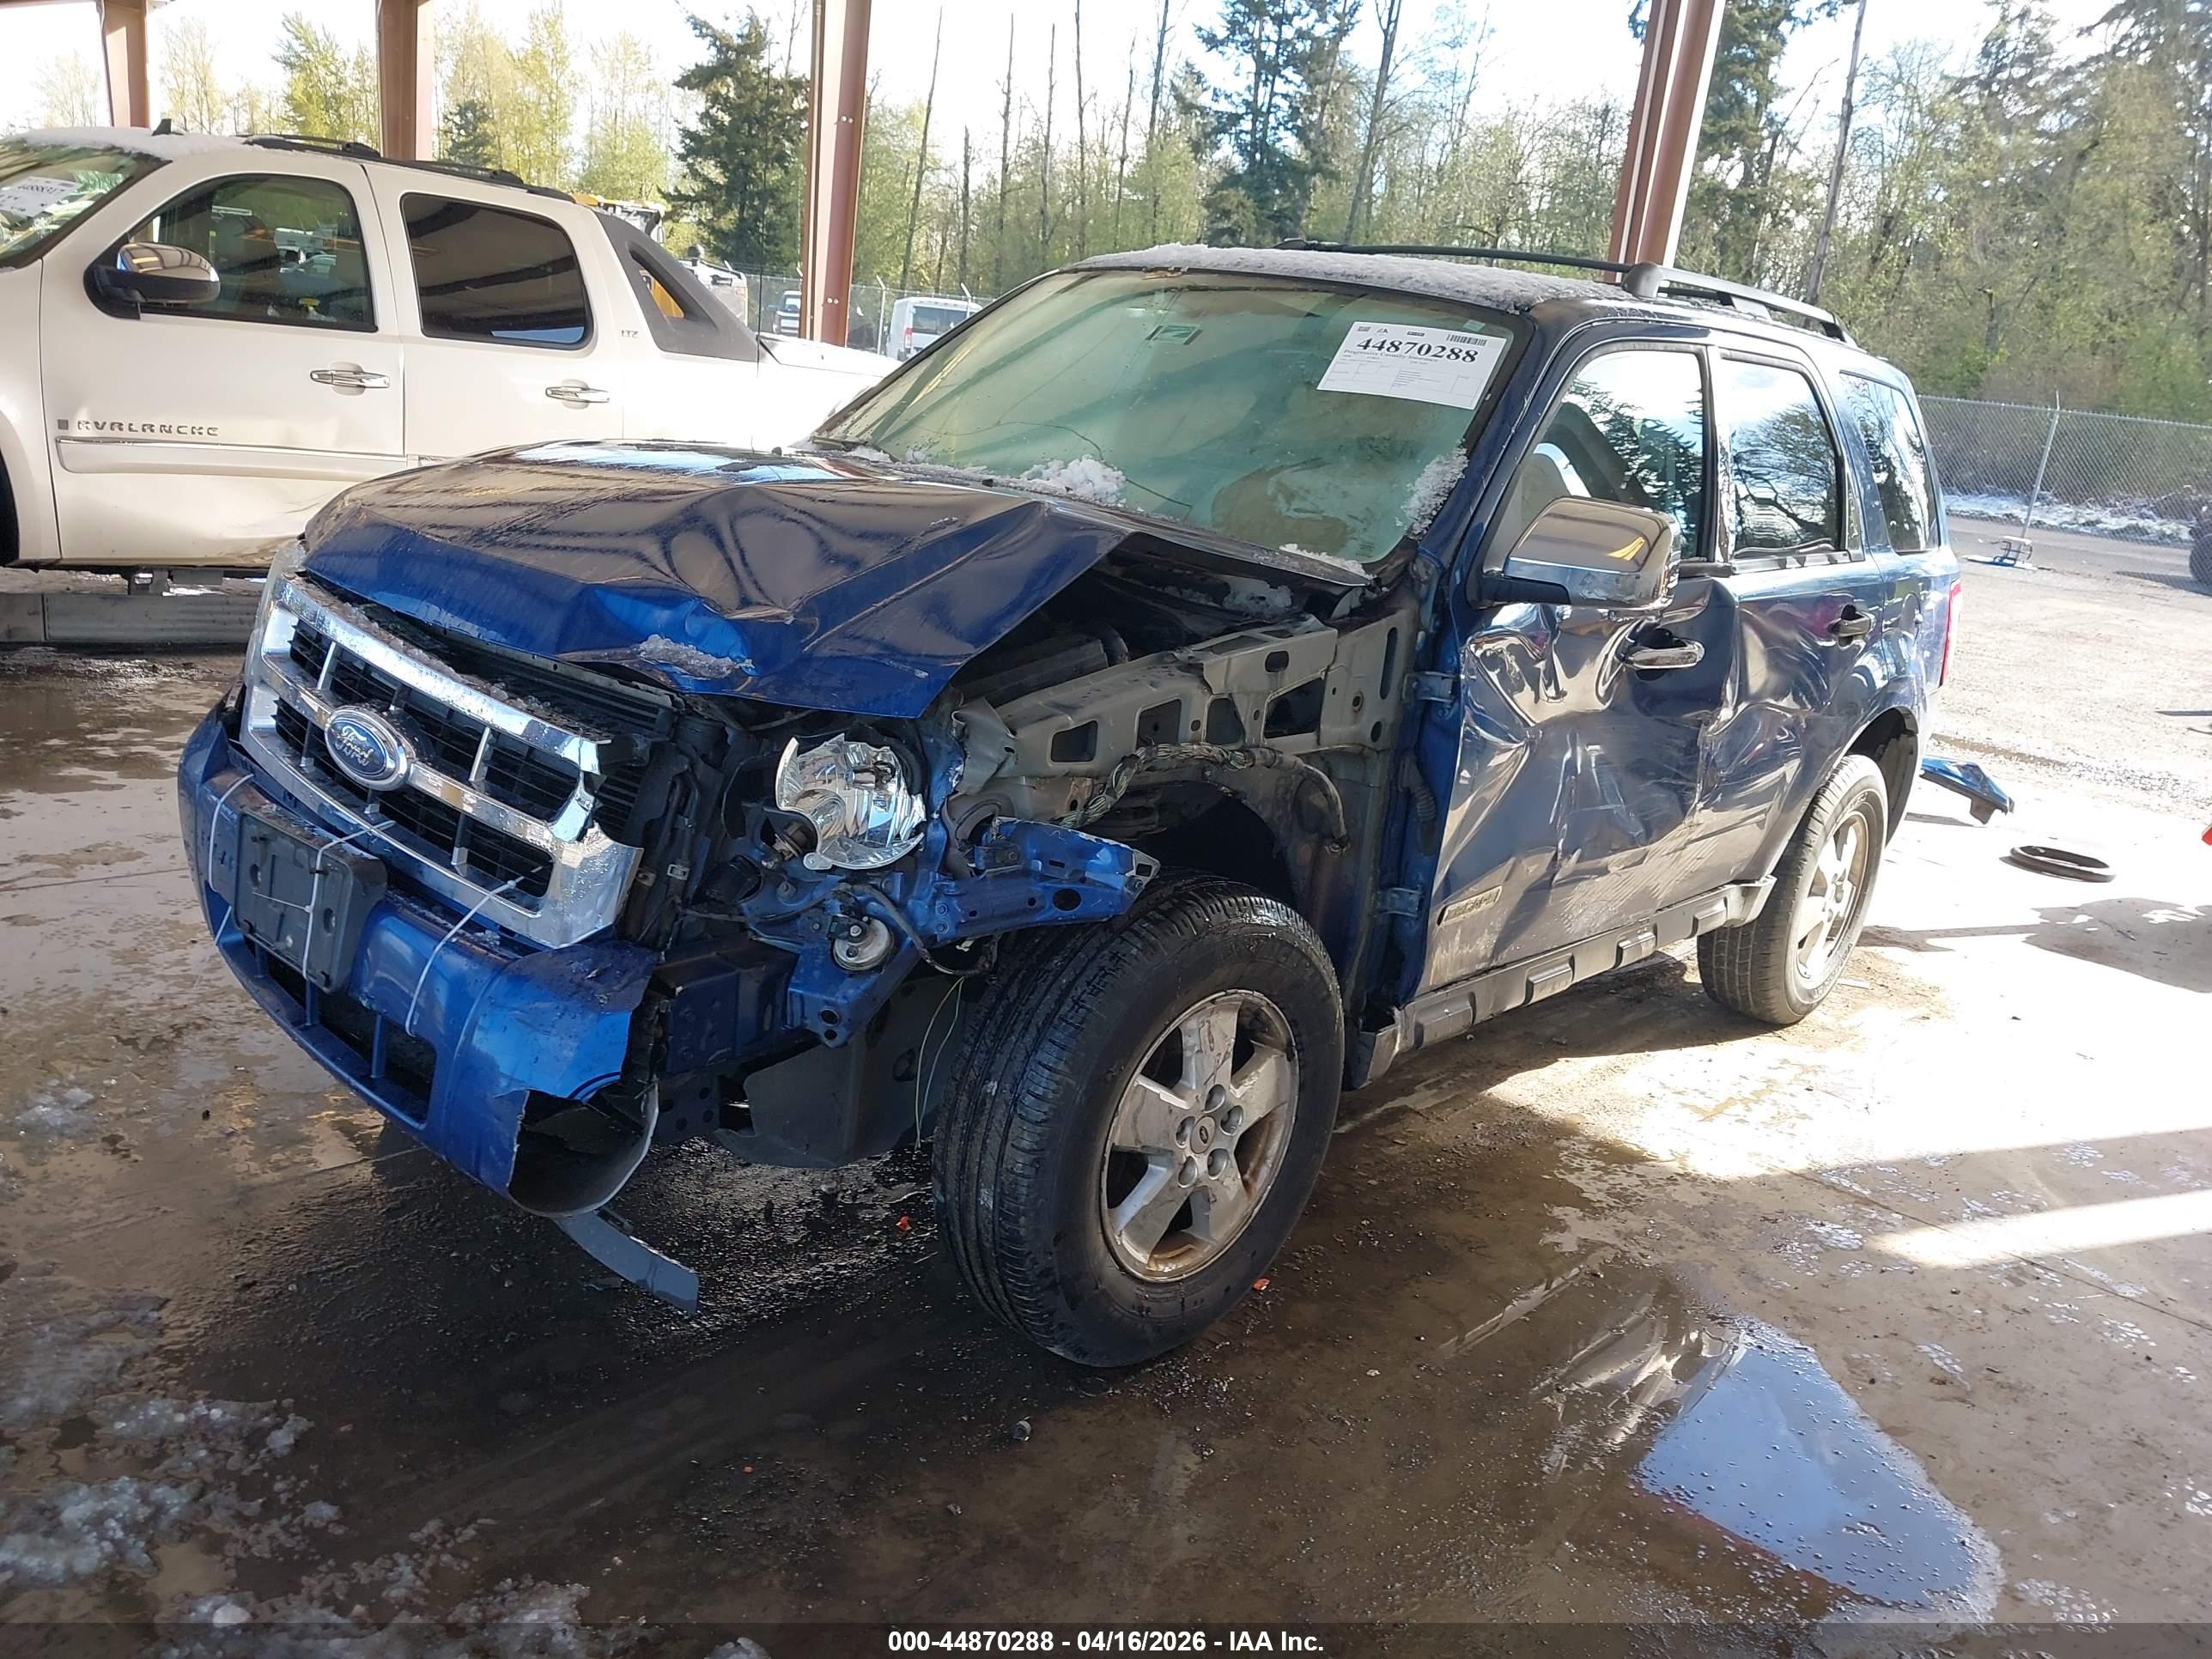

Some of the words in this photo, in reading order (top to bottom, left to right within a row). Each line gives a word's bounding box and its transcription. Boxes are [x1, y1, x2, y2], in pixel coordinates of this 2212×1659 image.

[1356, 337, 1479, 363] 44870288
[77, 419, 219, 436] AVALANCHE
[335, 725, 374, 766] Ford
